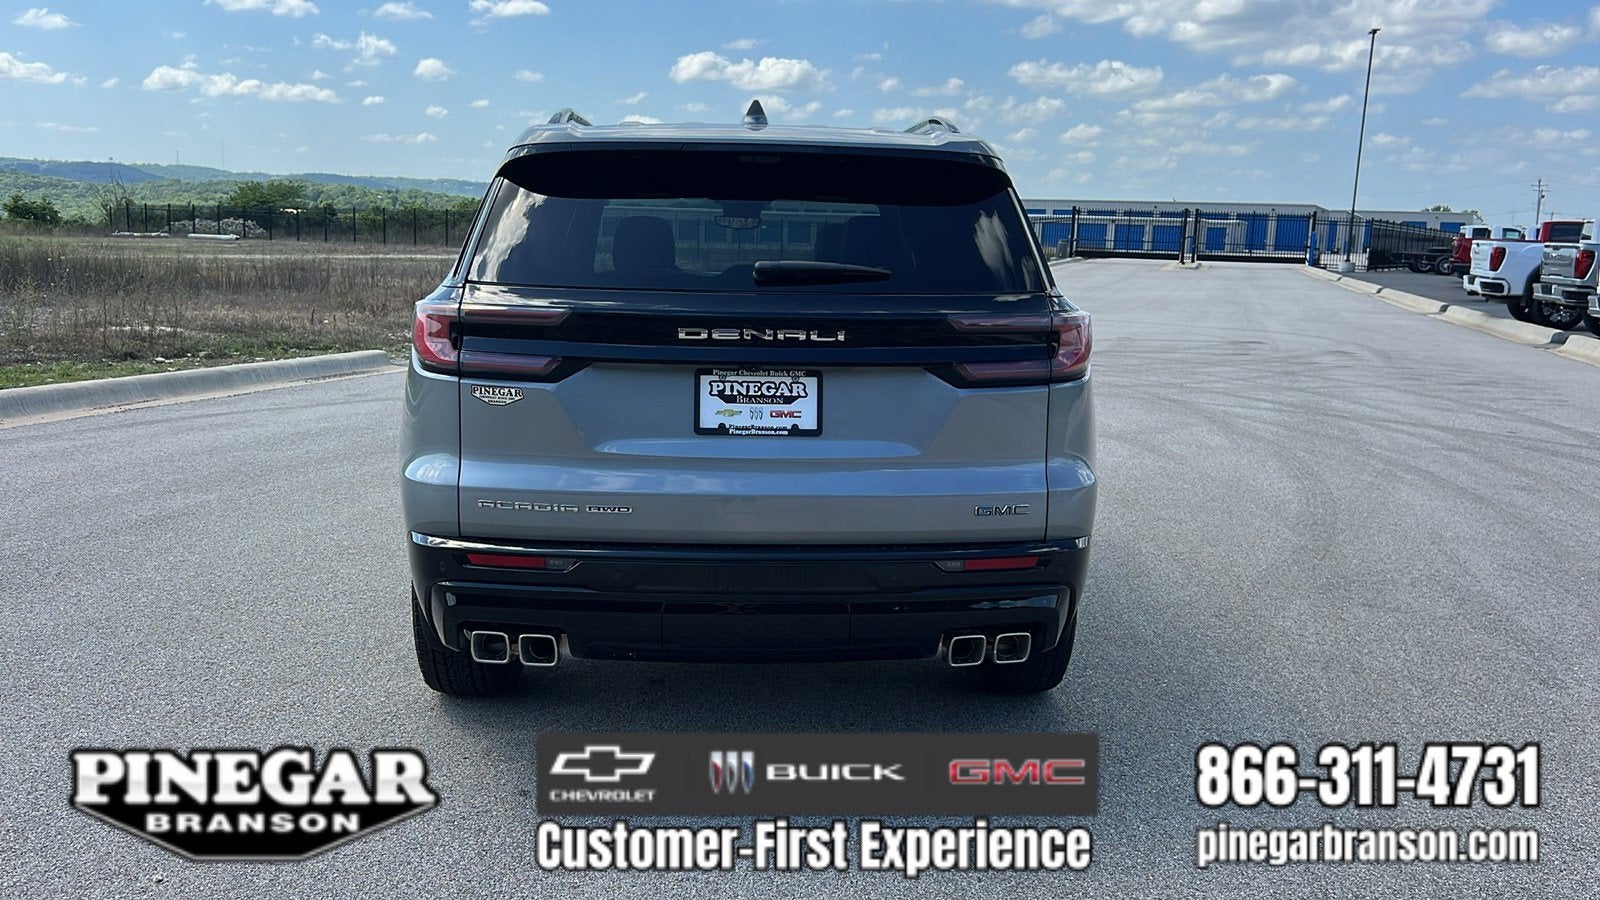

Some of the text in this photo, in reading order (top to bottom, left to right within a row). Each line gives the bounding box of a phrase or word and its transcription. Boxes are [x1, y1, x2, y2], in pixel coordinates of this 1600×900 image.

[678, 327, 845, 341] DENALI
[713, 369, 737, 377] Pinegar
[473, 386, 523, 398] PINEGAR
[710, 381, 807, 397] PINEGAR
[769, 410, 802, 418] GMC
[477, 499, 633, 513] ACADIA AWD
[974, 504, 1030, 516] GMC
